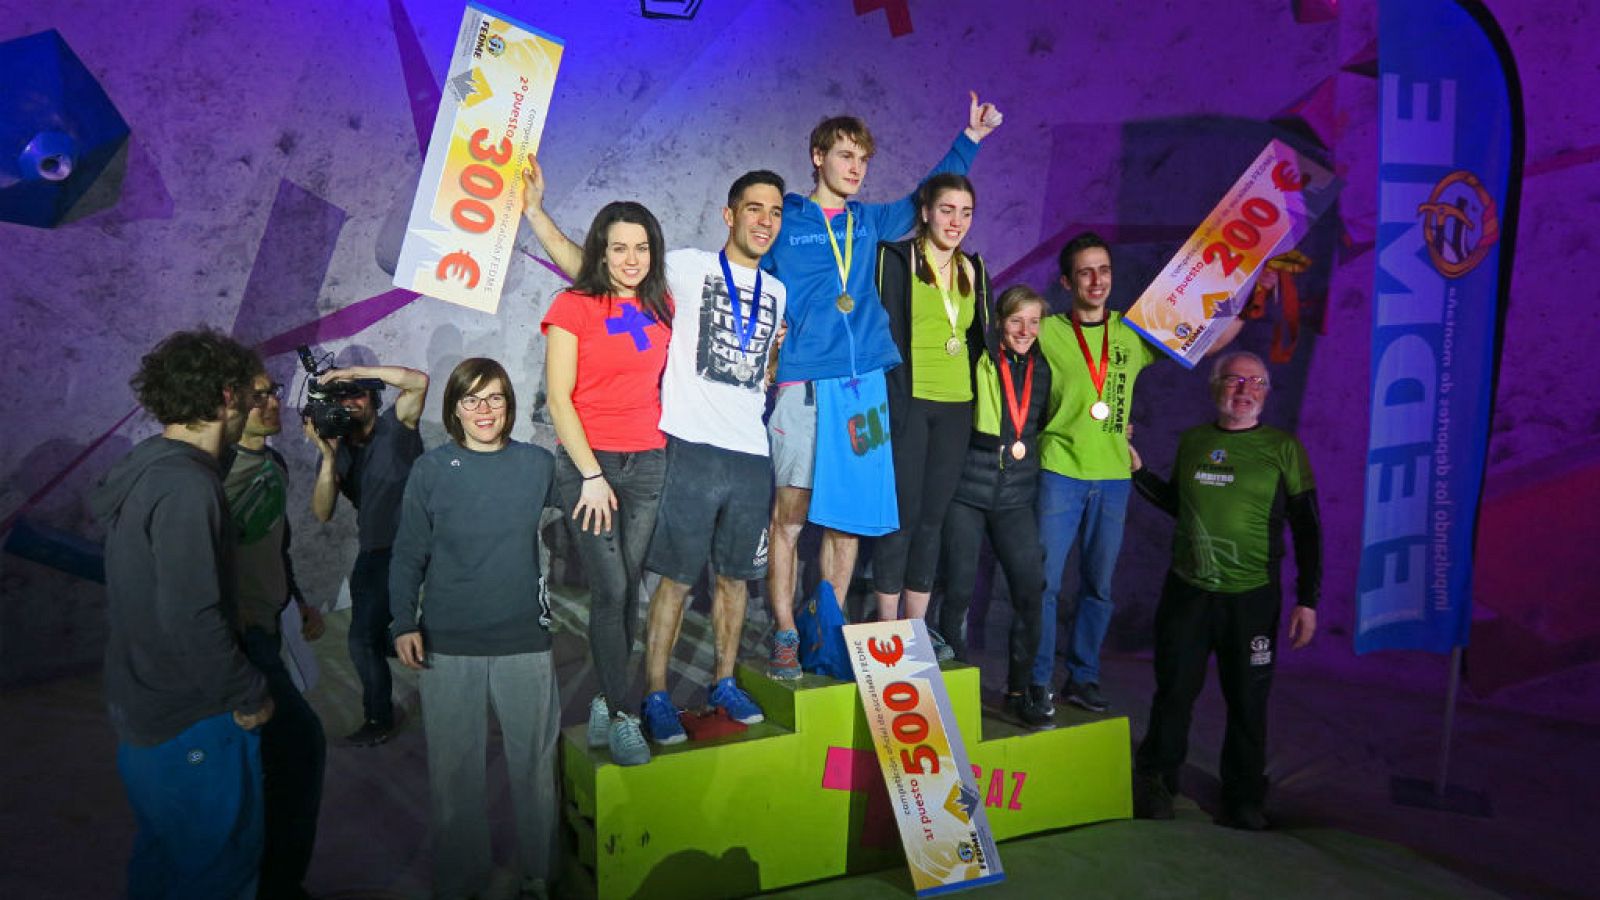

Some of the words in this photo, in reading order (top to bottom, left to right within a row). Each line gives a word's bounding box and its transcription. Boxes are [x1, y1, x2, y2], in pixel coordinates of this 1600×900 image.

[473, 20, 490, 59] FEDME
[506, 91, 526, 139] puesto
[452, 128, 513, 234] 300
[1203, 197, 1280, 278] 200
[1271, 160, 1311, 192] €
[436, 248, 481, 290] €
[484, 255, 501, 293] FEDME
[1175, 261, 1205, 296] puesto
[854, 640, 868, 673] FEDME
[867, 634, 904, 668] €
[882, 681, 940, 776] 500
[911, 779, 932, 824] puesto
